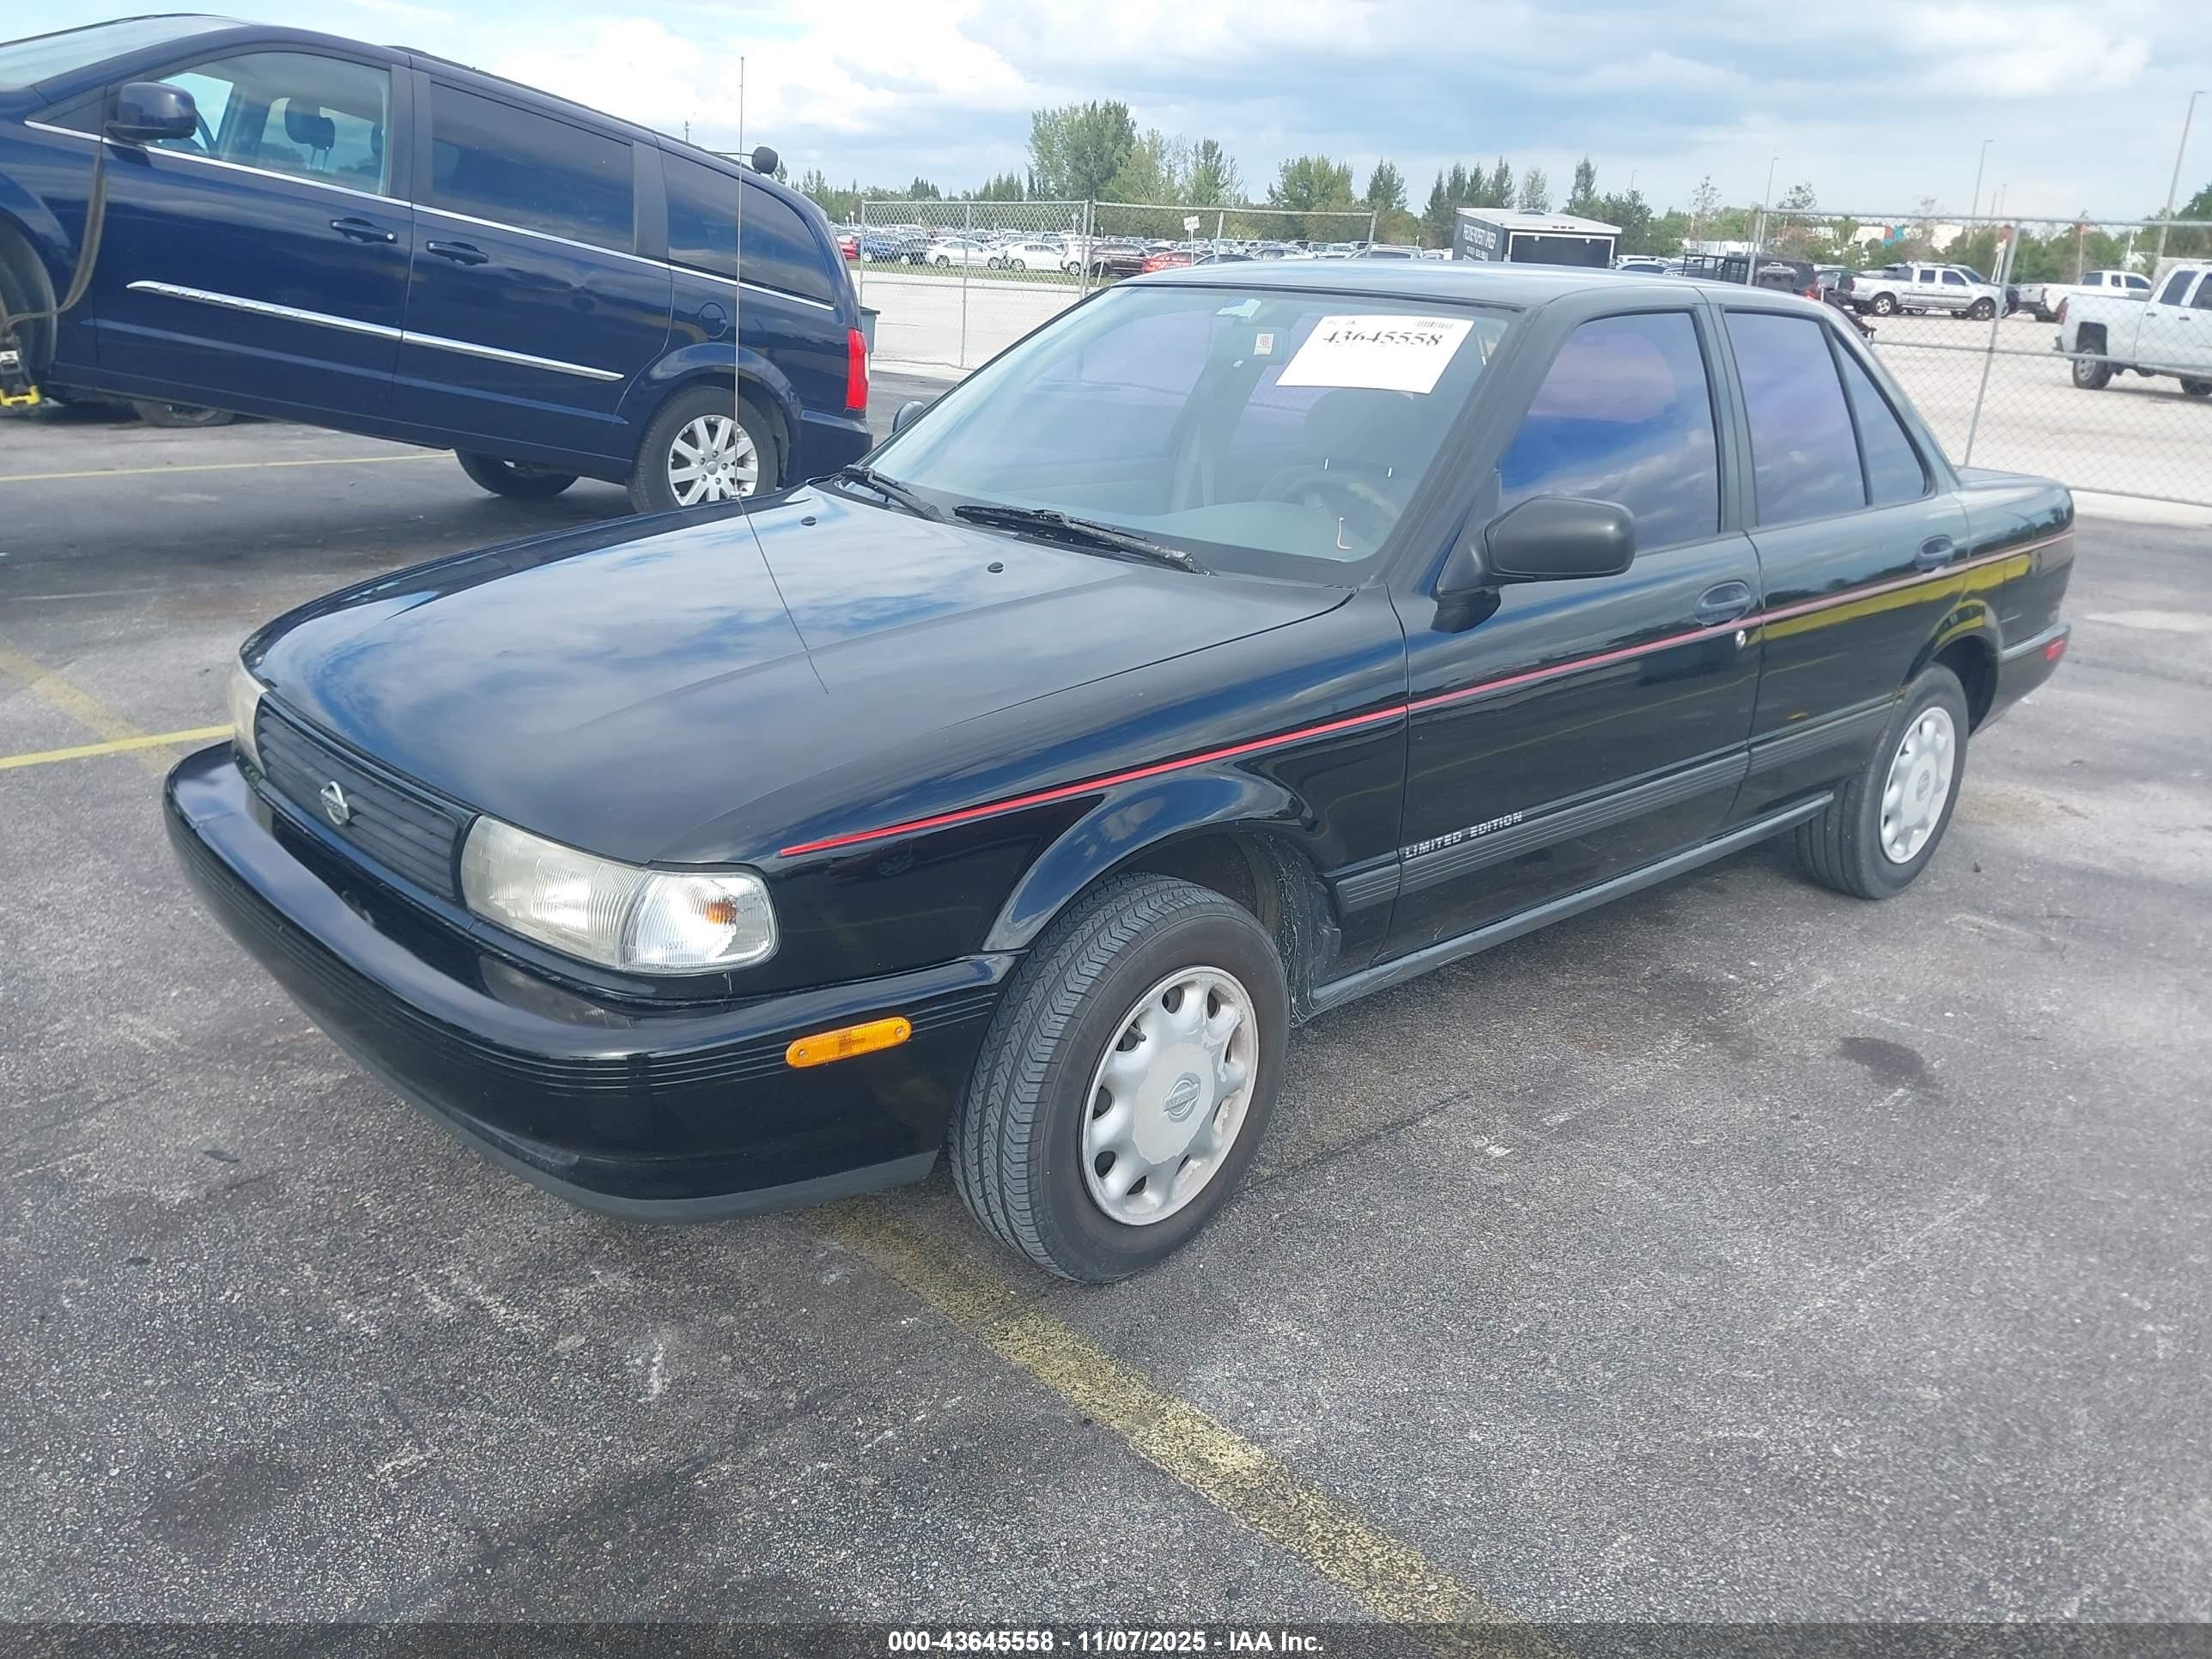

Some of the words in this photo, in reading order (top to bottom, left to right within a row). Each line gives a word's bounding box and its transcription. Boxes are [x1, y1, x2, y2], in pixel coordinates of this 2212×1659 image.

[1323, 331, 1443, 346] 43645558
[1406, 831, 1462, 859] LIMITED
[1469, 811, 1522, 837] EDITION
